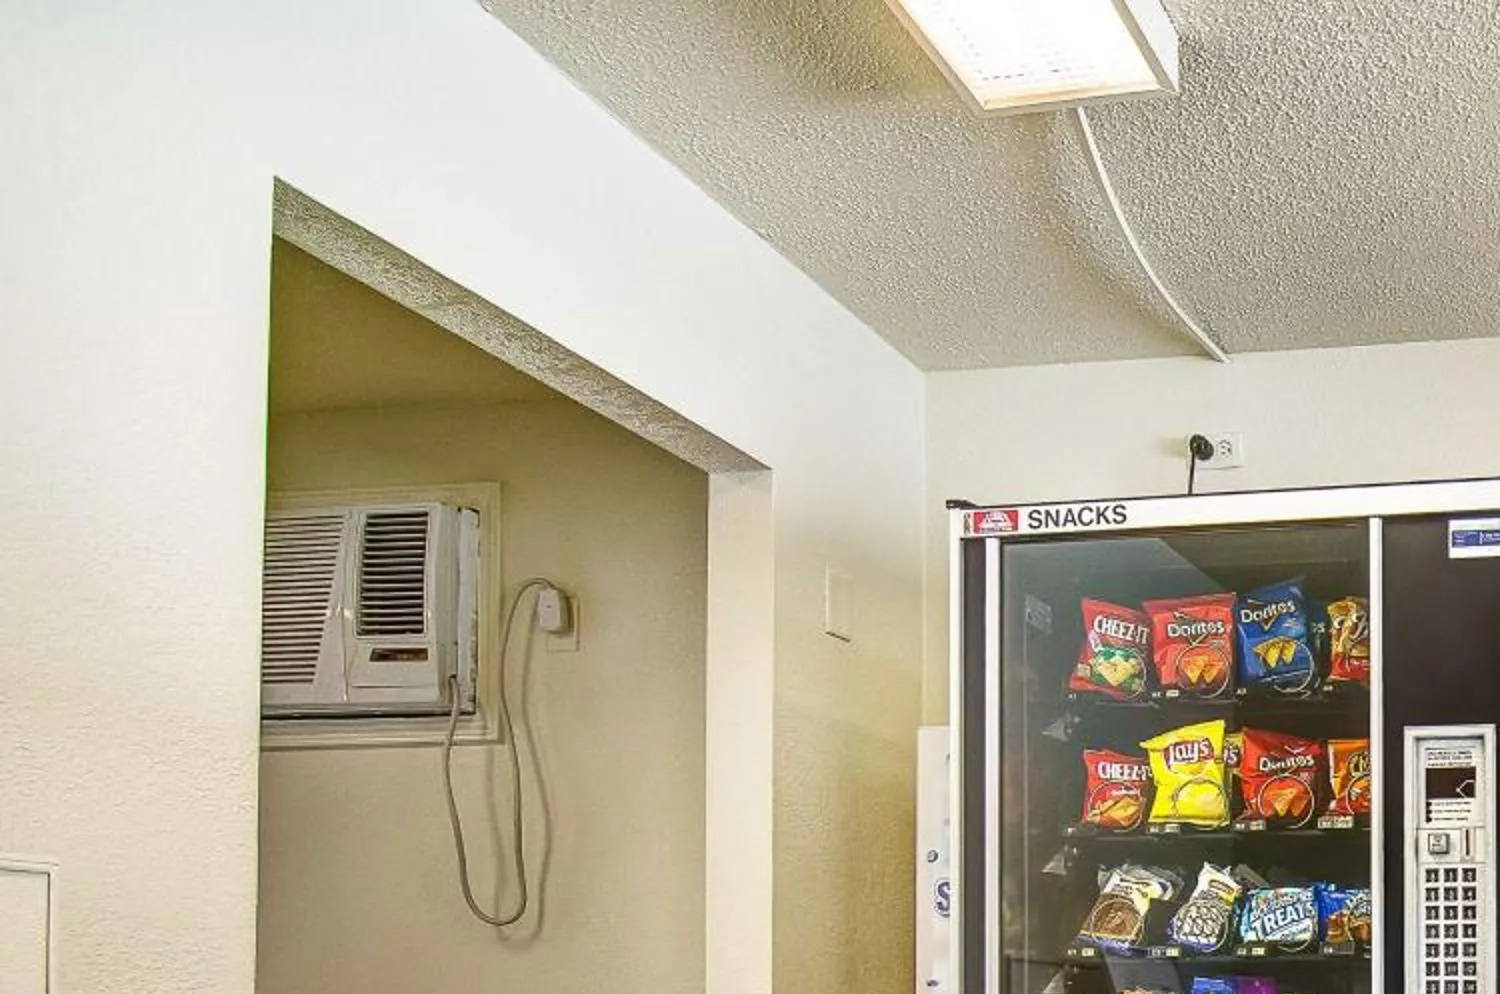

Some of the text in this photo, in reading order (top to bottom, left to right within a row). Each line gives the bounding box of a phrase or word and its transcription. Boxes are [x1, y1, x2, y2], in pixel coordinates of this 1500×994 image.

[1027, 504, 1128, 529] SNACKS
[1240, 599, 1296, 624] Doritos
[1167, 620, 1225, 637] Doritos
[1259, 754, 1316, 773] Doritos
